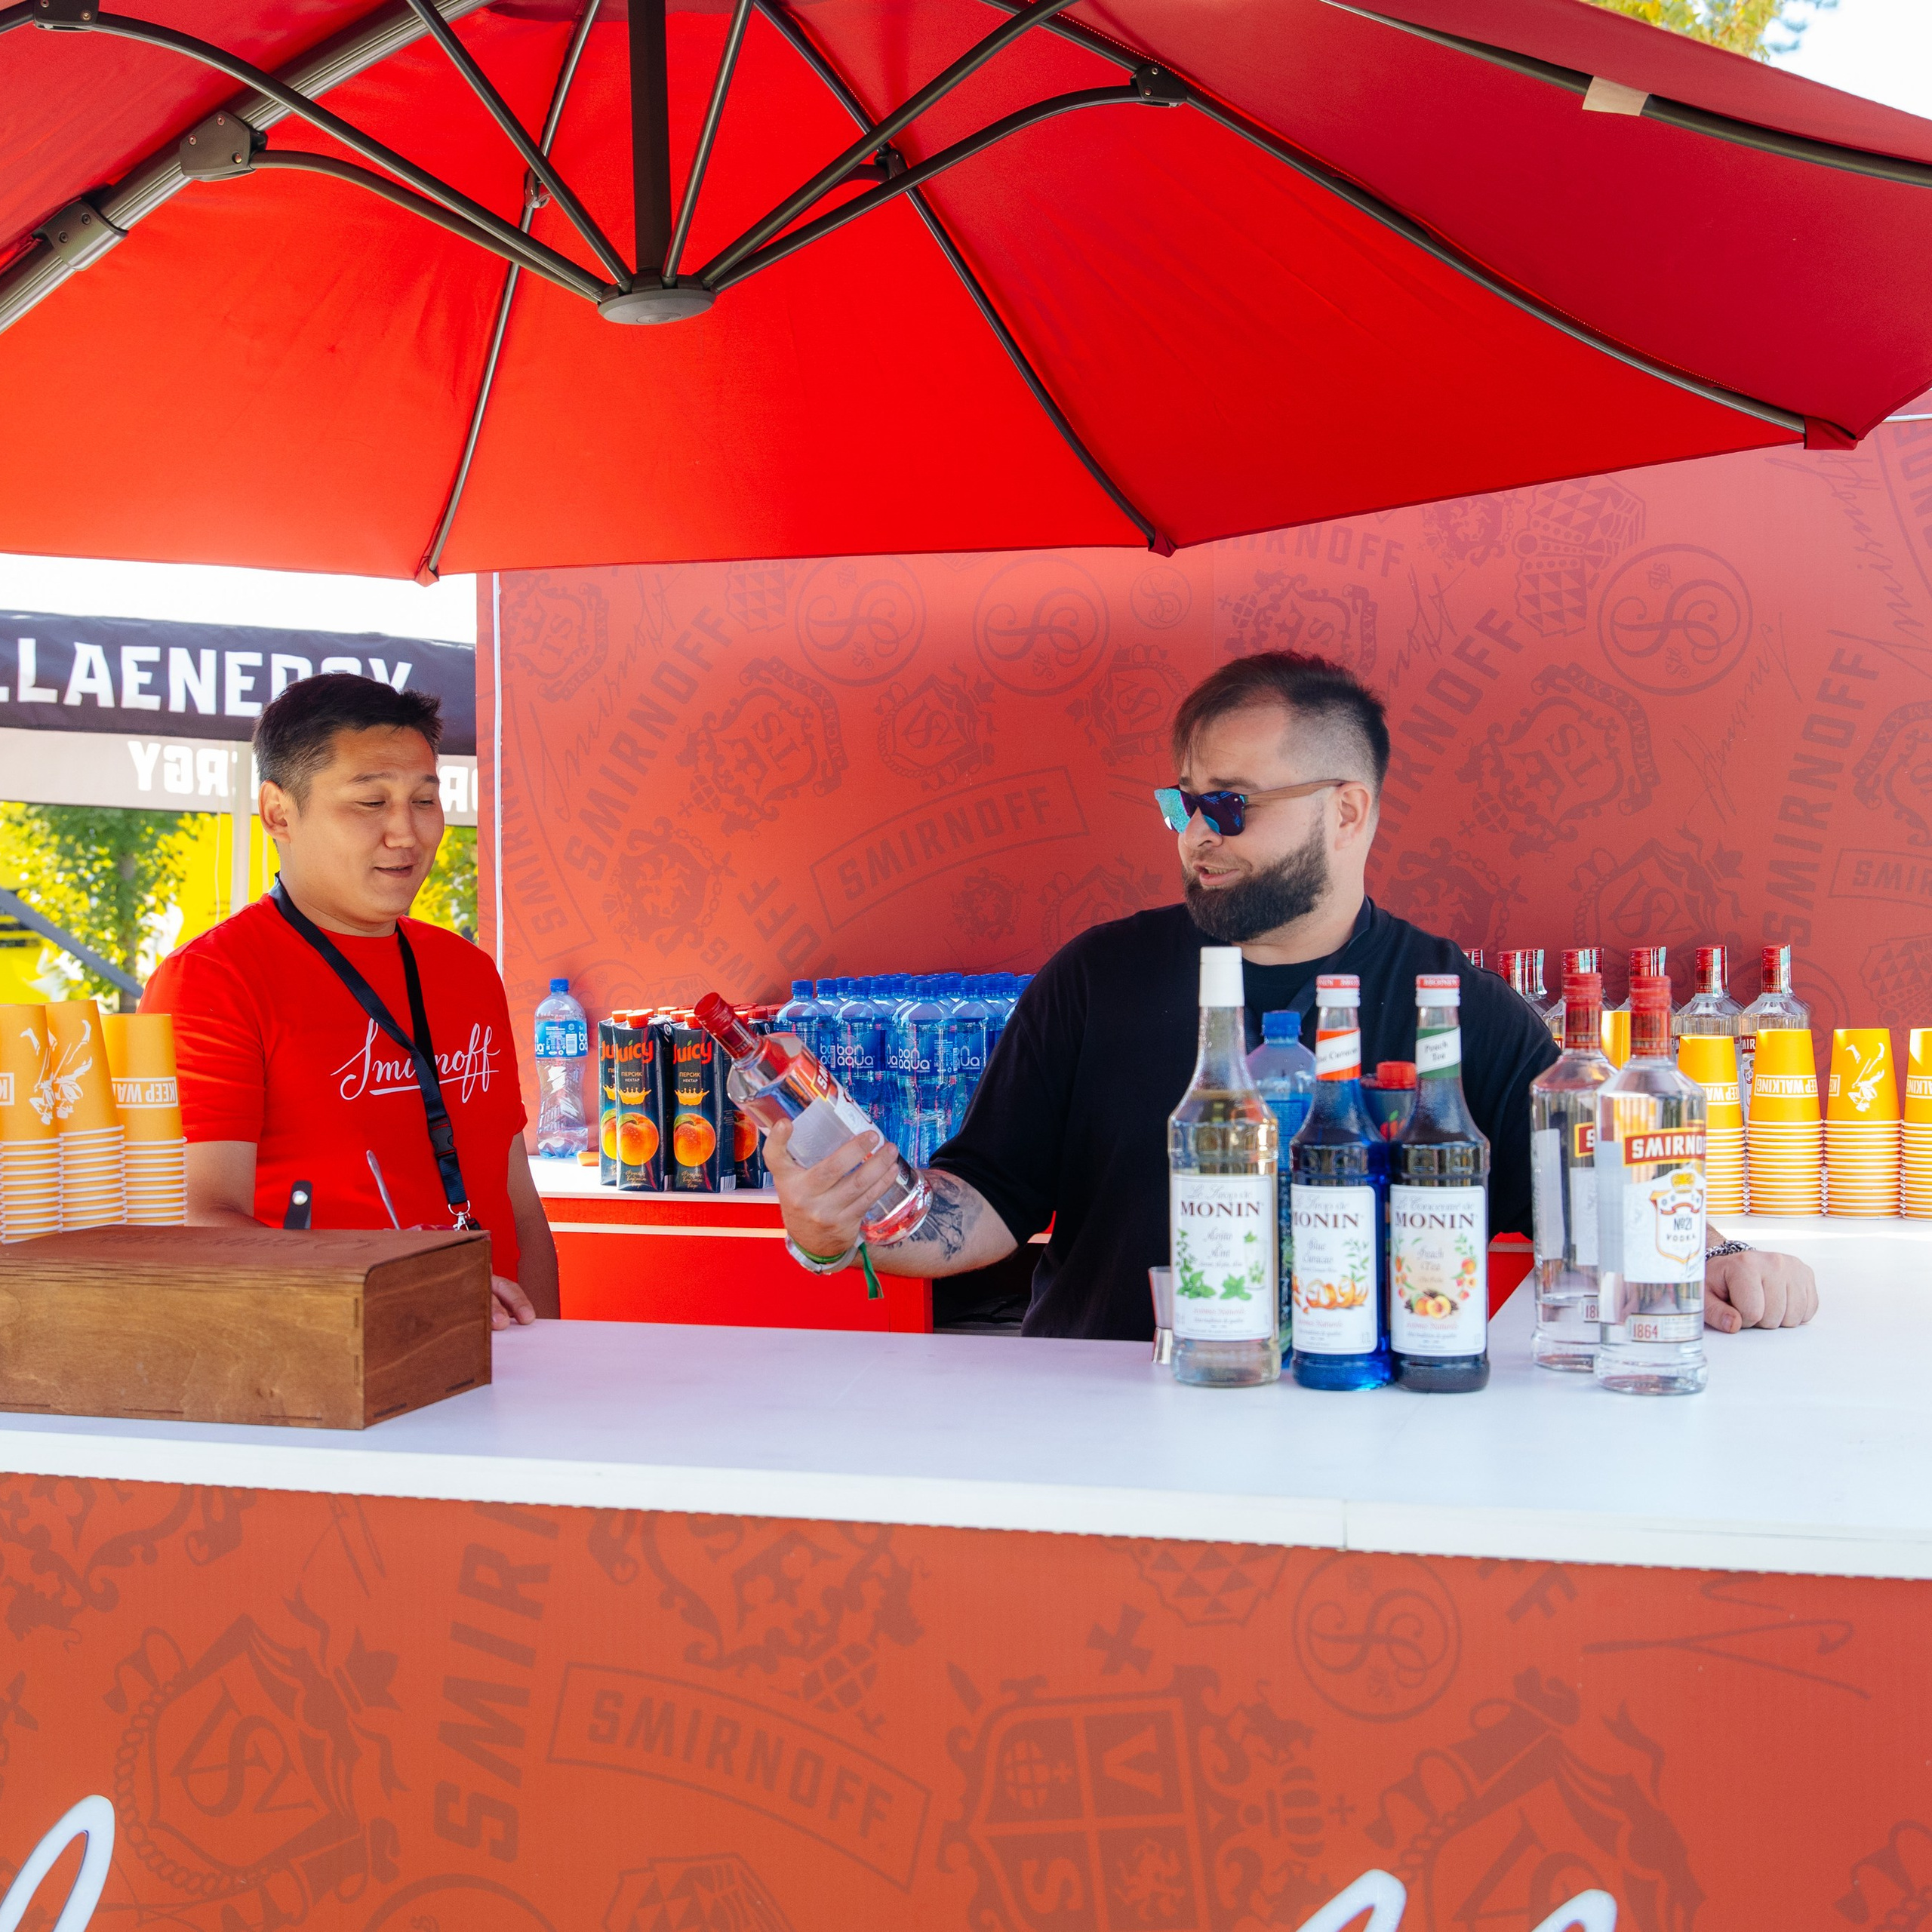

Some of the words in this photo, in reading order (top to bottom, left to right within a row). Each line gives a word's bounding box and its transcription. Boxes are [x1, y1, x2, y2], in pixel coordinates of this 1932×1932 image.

[565, 605, 735, 881] SMIRNOFF
[1761, 648, 1879, 948] SMIRNOFF
[837, 786, 1051, 901] SMIRNOFF
[330, 1018, 500, 1103] Sminoff
[615, 1039, 654, 1064] Juicy
[672, 1039, 712, 1065] Juicy
[146, 1083, 175, 1103] KEEP
[1756, 1078, 1805, 1094] WALKING
[1180, 1200, 1260, 1217] MONIN
[1395, 1212, 1475, 1229] MONIN
[1633, 1323, 1659, 1339] 1864
[587, 1687, 896, 1841] SMIRNOFF
